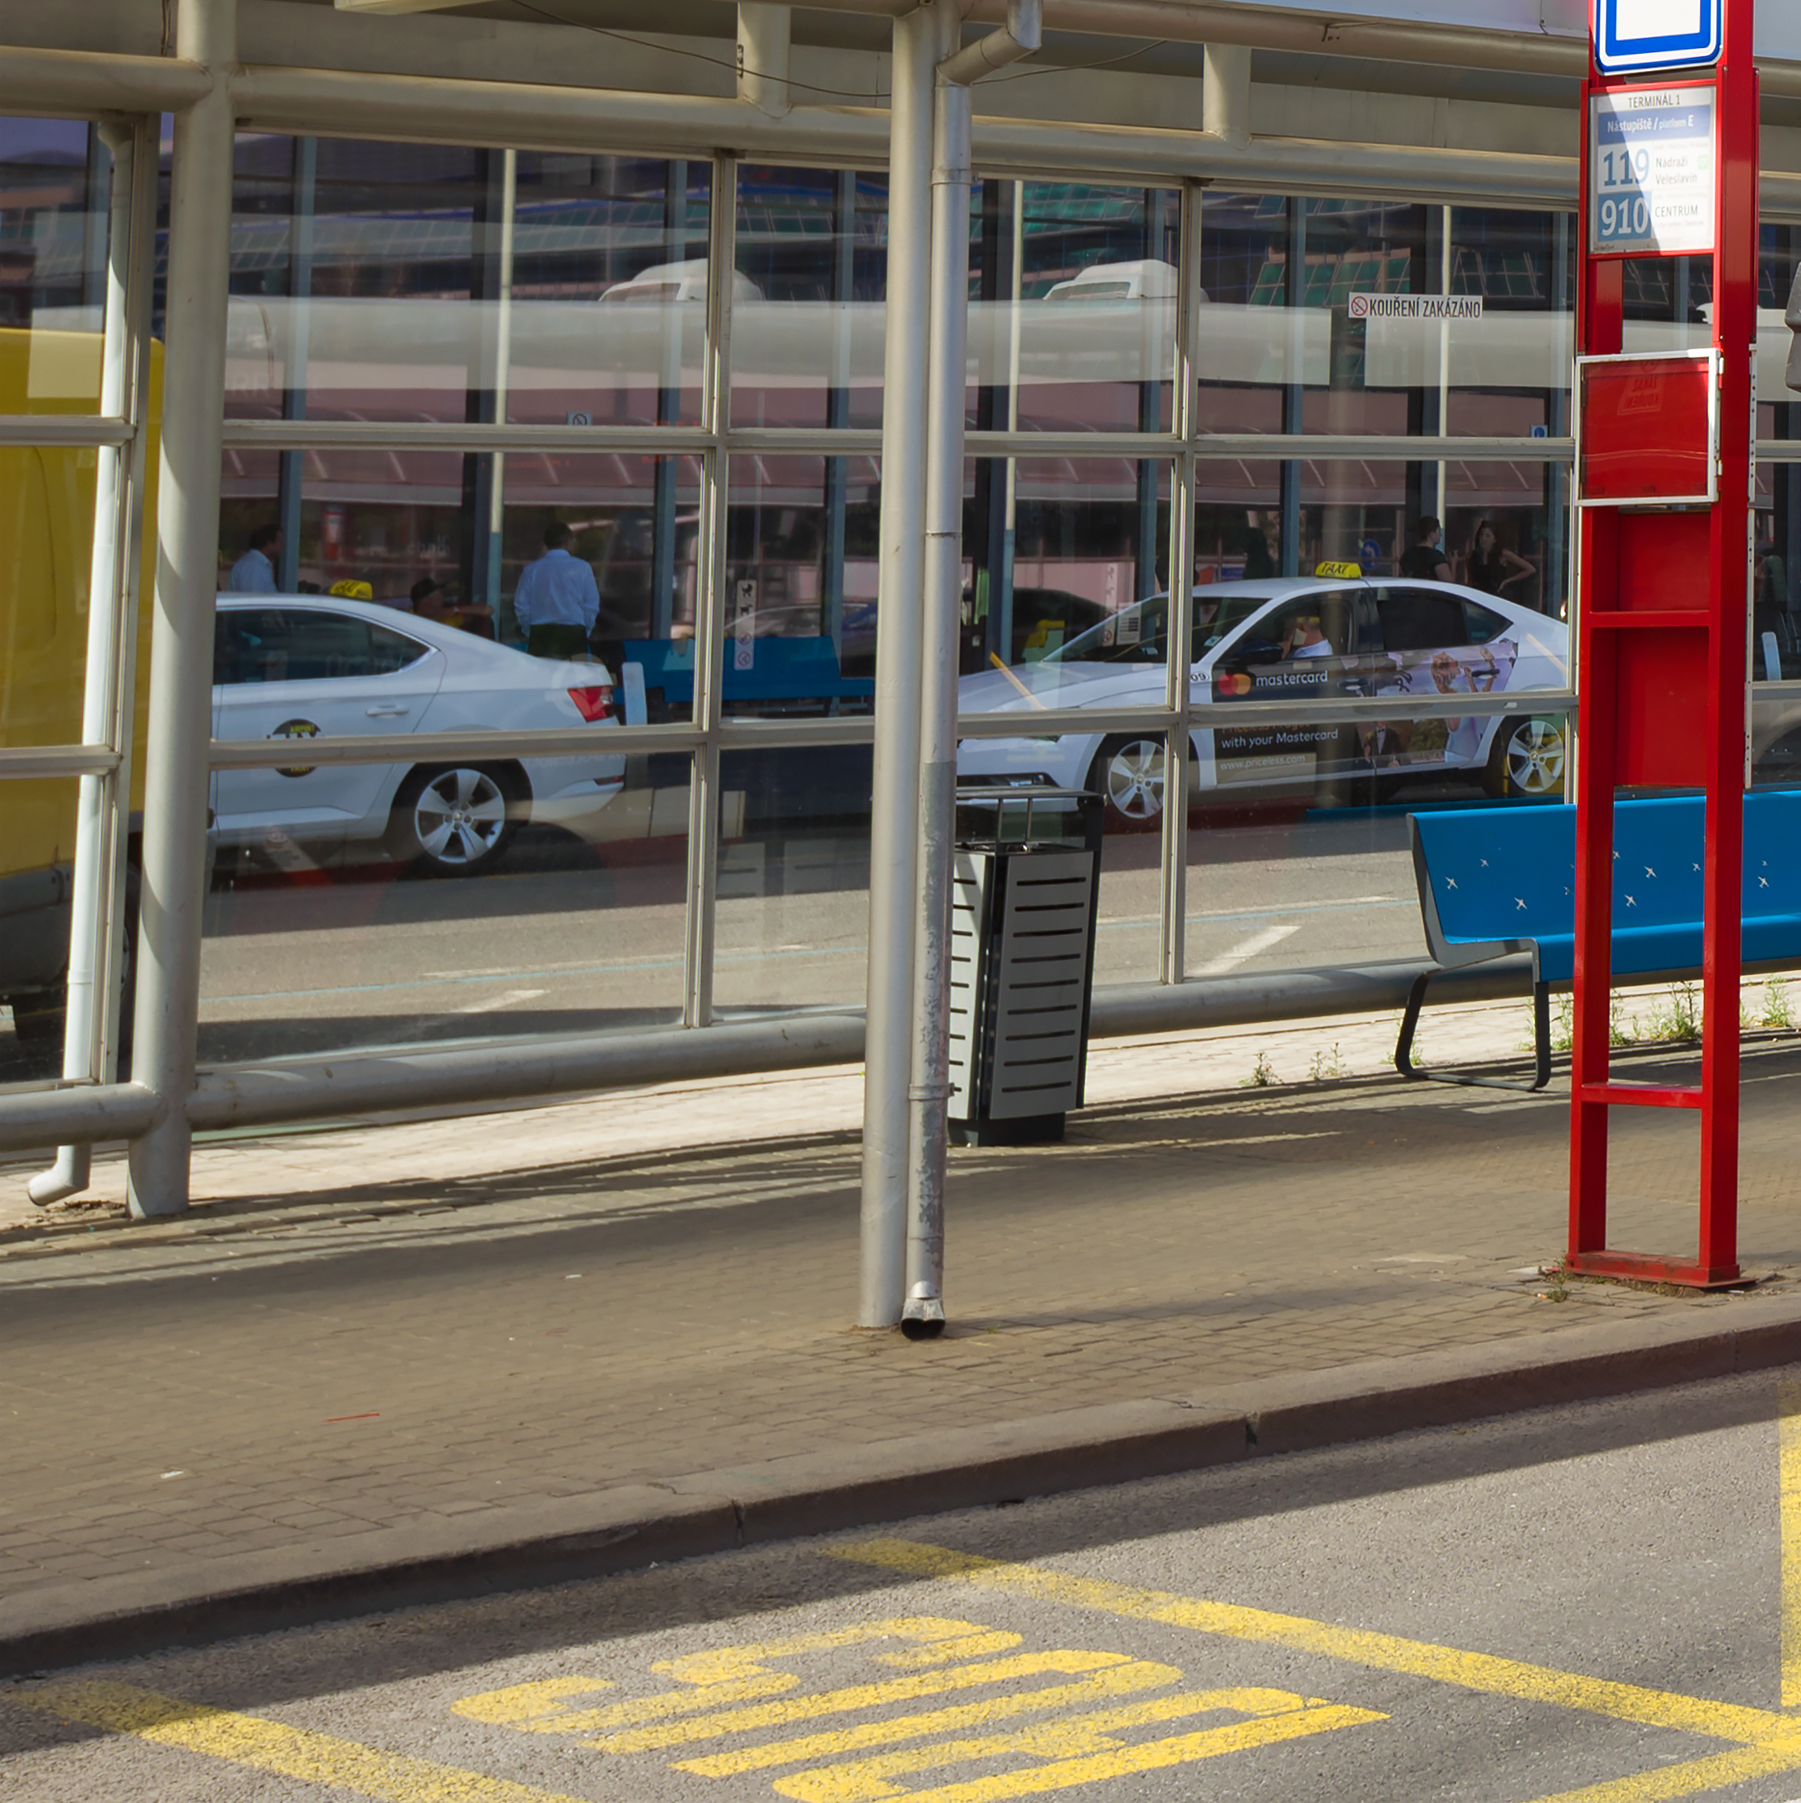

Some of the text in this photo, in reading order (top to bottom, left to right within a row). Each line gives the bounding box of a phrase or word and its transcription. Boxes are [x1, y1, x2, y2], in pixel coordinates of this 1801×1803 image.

[1628, 93, 1681, 108] TERMINÁL 1
[1687, 114, 1694, 128] E
[1603, 148, 1650, 187] 119
[1601, 196, 1649, 237] 910
[1654, 204, 1699, 218] CENTRUM
[1369, 295, 1481, 318] KOUŘENÍ ZAKÁZÁNO
[1321, 562, 1349, 575] TAXI
[1190, 672, 1207, 682] 09
[1255, 670, 1329, 687] mastercard
[1221, 728, 1339, 749] with your Mastercard
